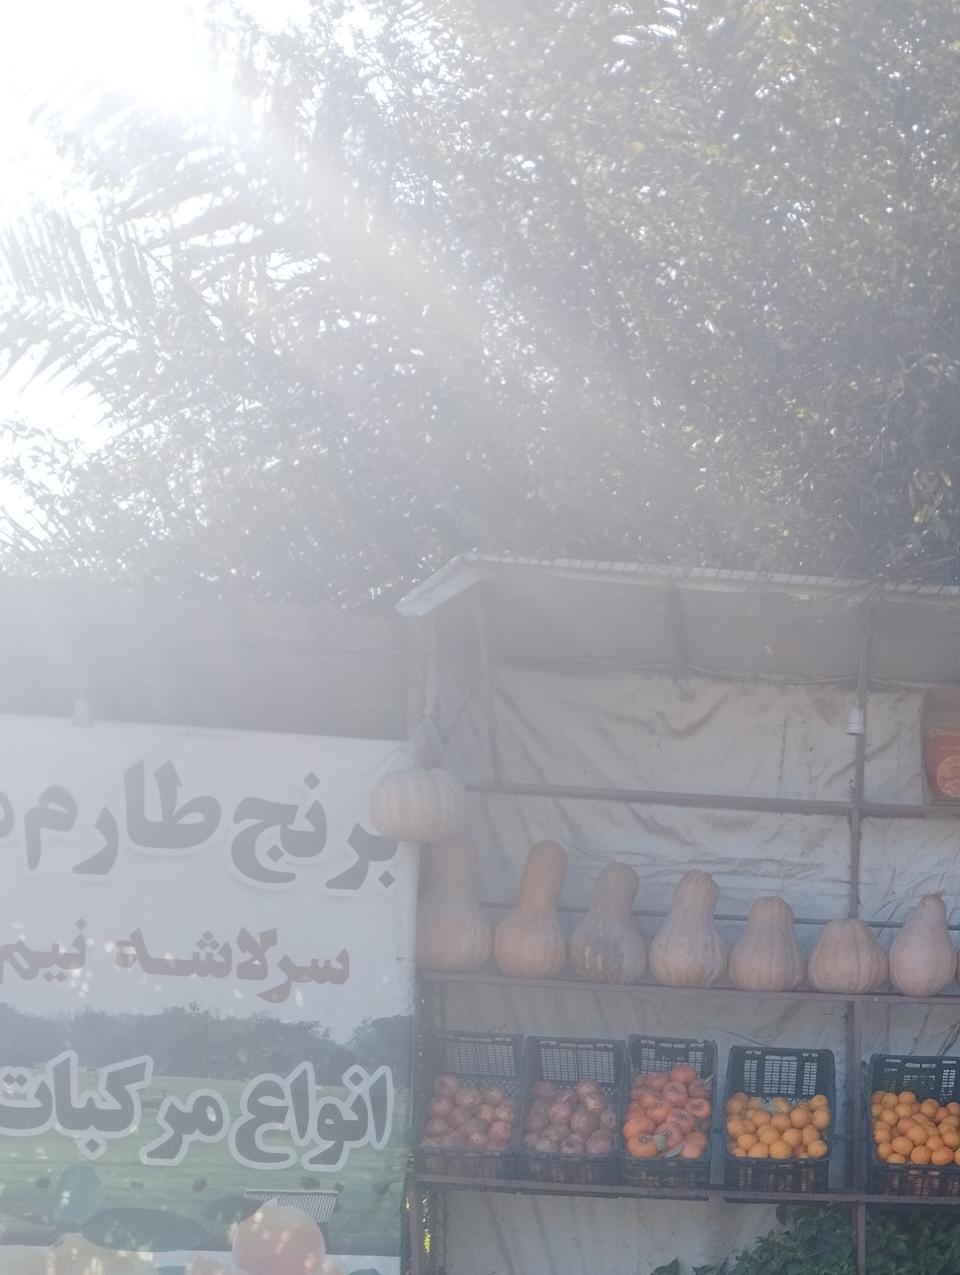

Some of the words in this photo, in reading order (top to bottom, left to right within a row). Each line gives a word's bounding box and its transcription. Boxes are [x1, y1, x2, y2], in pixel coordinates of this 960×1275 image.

[24, 757, 222, 875] طارم
[230, 770, 398, 890] برنج
[231, 1064, 391, 1168] انواع
